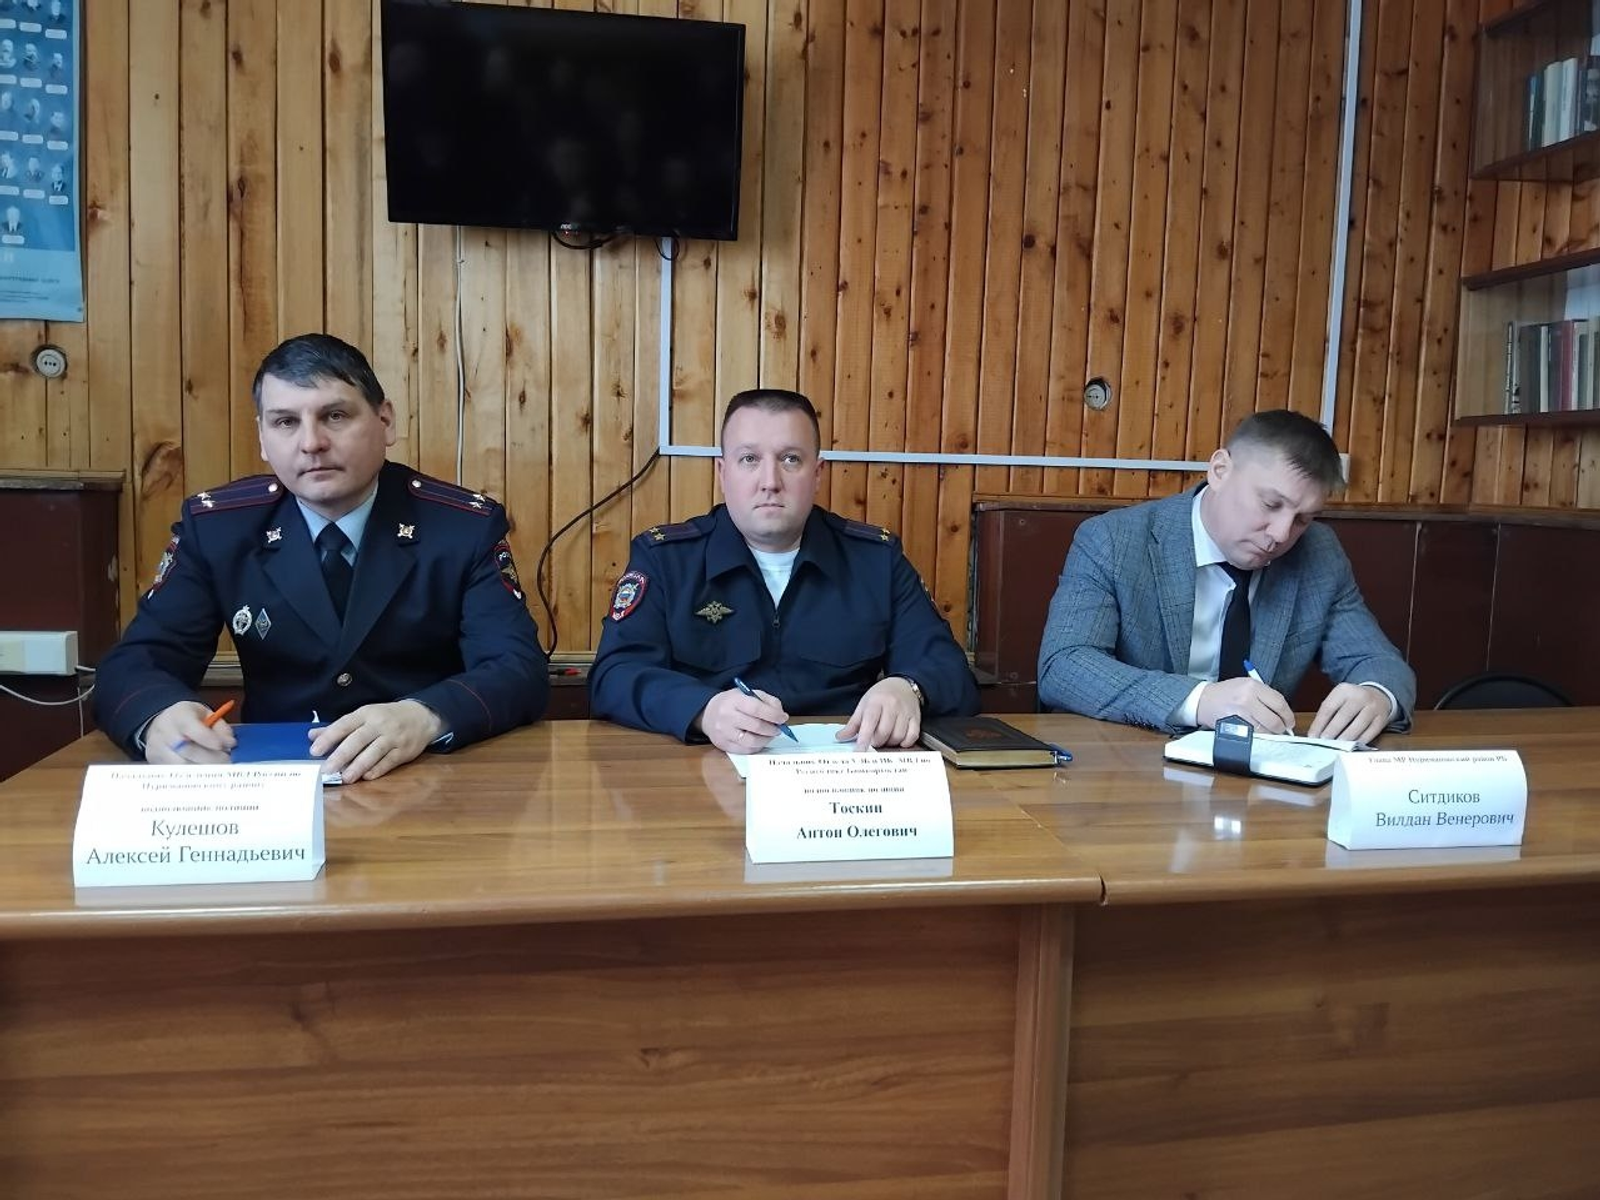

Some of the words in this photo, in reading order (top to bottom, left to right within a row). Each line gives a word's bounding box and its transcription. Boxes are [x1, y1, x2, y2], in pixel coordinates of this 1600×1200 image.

[1408, 789, 1480, 805] Ситдиков
[829, 801, 883, 815] Тоскин
[1376, 811, 1431, 827] Вилдан
[1436, 811, 1514, 828] Венерович
[150, 819, 240, 841] Кулешов
[796, 826, 843, 840] Антон
[846, 824, 918, 839] Олегович
[86, 845, 171, 865] Алексей
[178, 846, 305, 864] Геннадьевич
